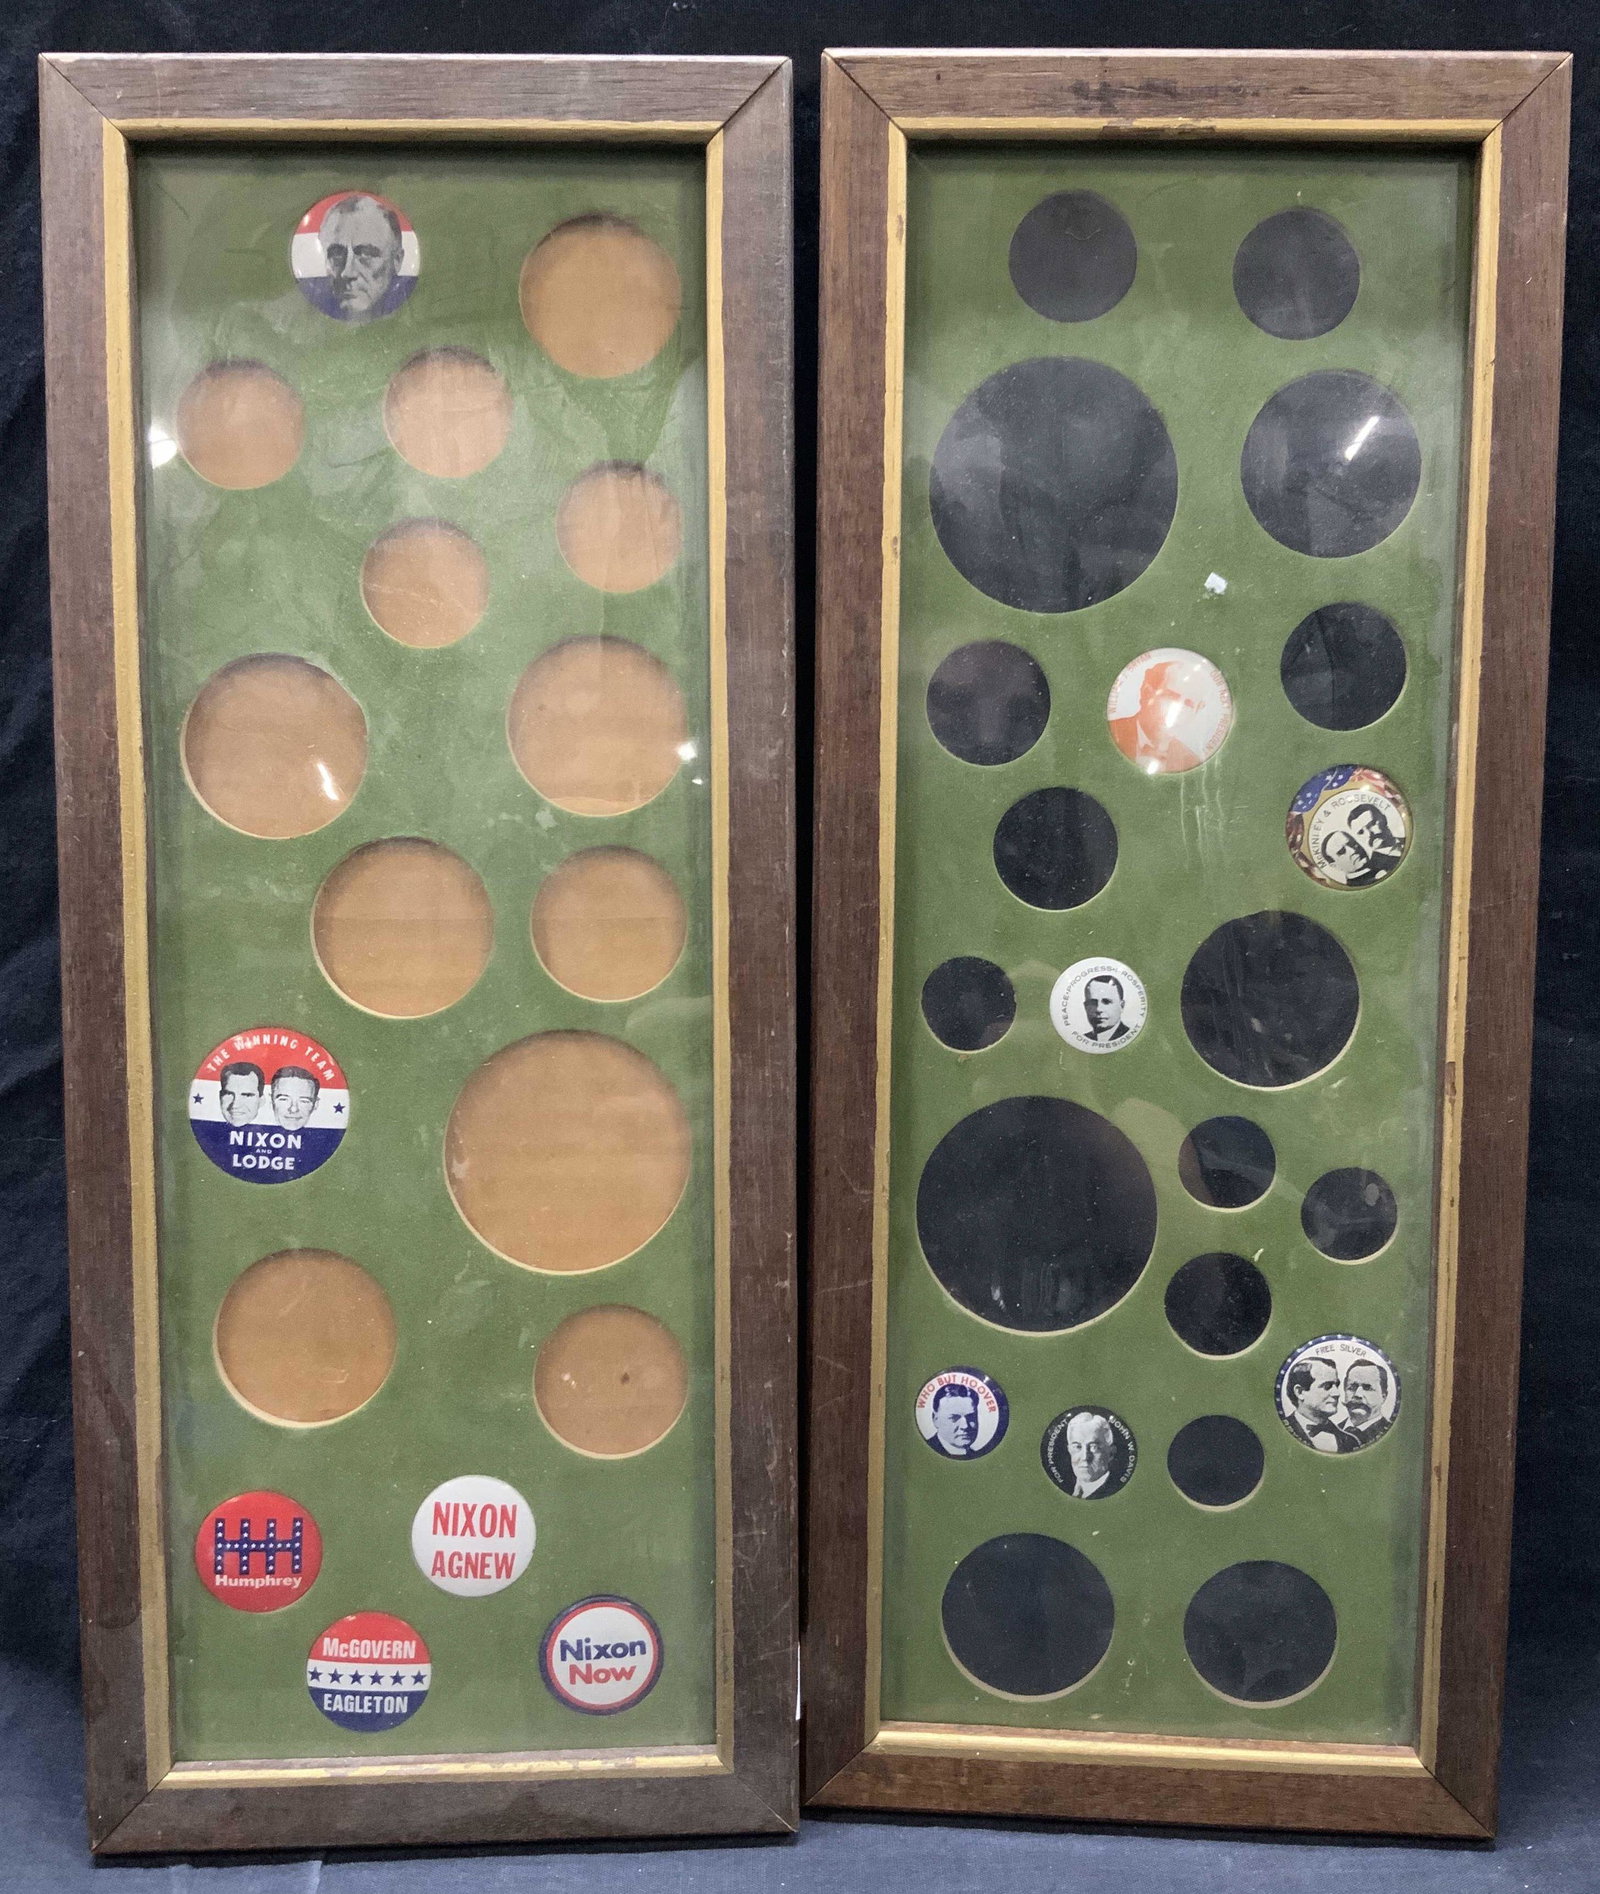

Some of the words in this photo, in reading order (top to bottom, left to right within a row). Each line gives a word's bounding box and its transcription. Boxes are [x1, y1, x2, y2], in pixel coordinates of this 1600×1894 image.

[1210, 669, 1225, 686] OUR
[1323, 809, 1332, 817] &
[1331, 793, 1392, 811] ROOSEVELT
[1072, 1030, 1090, 1046] FOR
[1091, 1023, 1141, 1049] PRESIDENT
[206, 1048, 231, 1073] THE
[234, 1034, 299, 1051] WINNING
[304, 1046, 336, 1082] TEAM
[229, 1130, 302, 1149] NIXON
[232, 1154, 296, 1171] LODGE
[1315, 1345, 1336, 1356] FREE
[1339, 1343, 1367, 1358] SILVER
[917, 1383, 936, 1409] WHO
[936, 1374, 957, 1387] BUT
[960, 1376, 997, 1413] HOOVER
[1108, 1417, 1131, 1440] JOHN
[1046, 1418, 1069, 1465] PRESIDENT
[1050, 1466, 1064, 1484] FOR
[1119, 1455, 1136, 1483] DAVIS
[432, 1501, 518, 1538] NIXON
[431, 1550, 517, 1580] AGNEW
[215, 1574, 303, 1589] Humphrey
[322, 1637, 417, 1659] McGOVERN
[560, 1637, 647, 1662] Nixon
[569, 1663, 637, 1686] Now
[323, 1692, 409, 1714] EAGLETON
